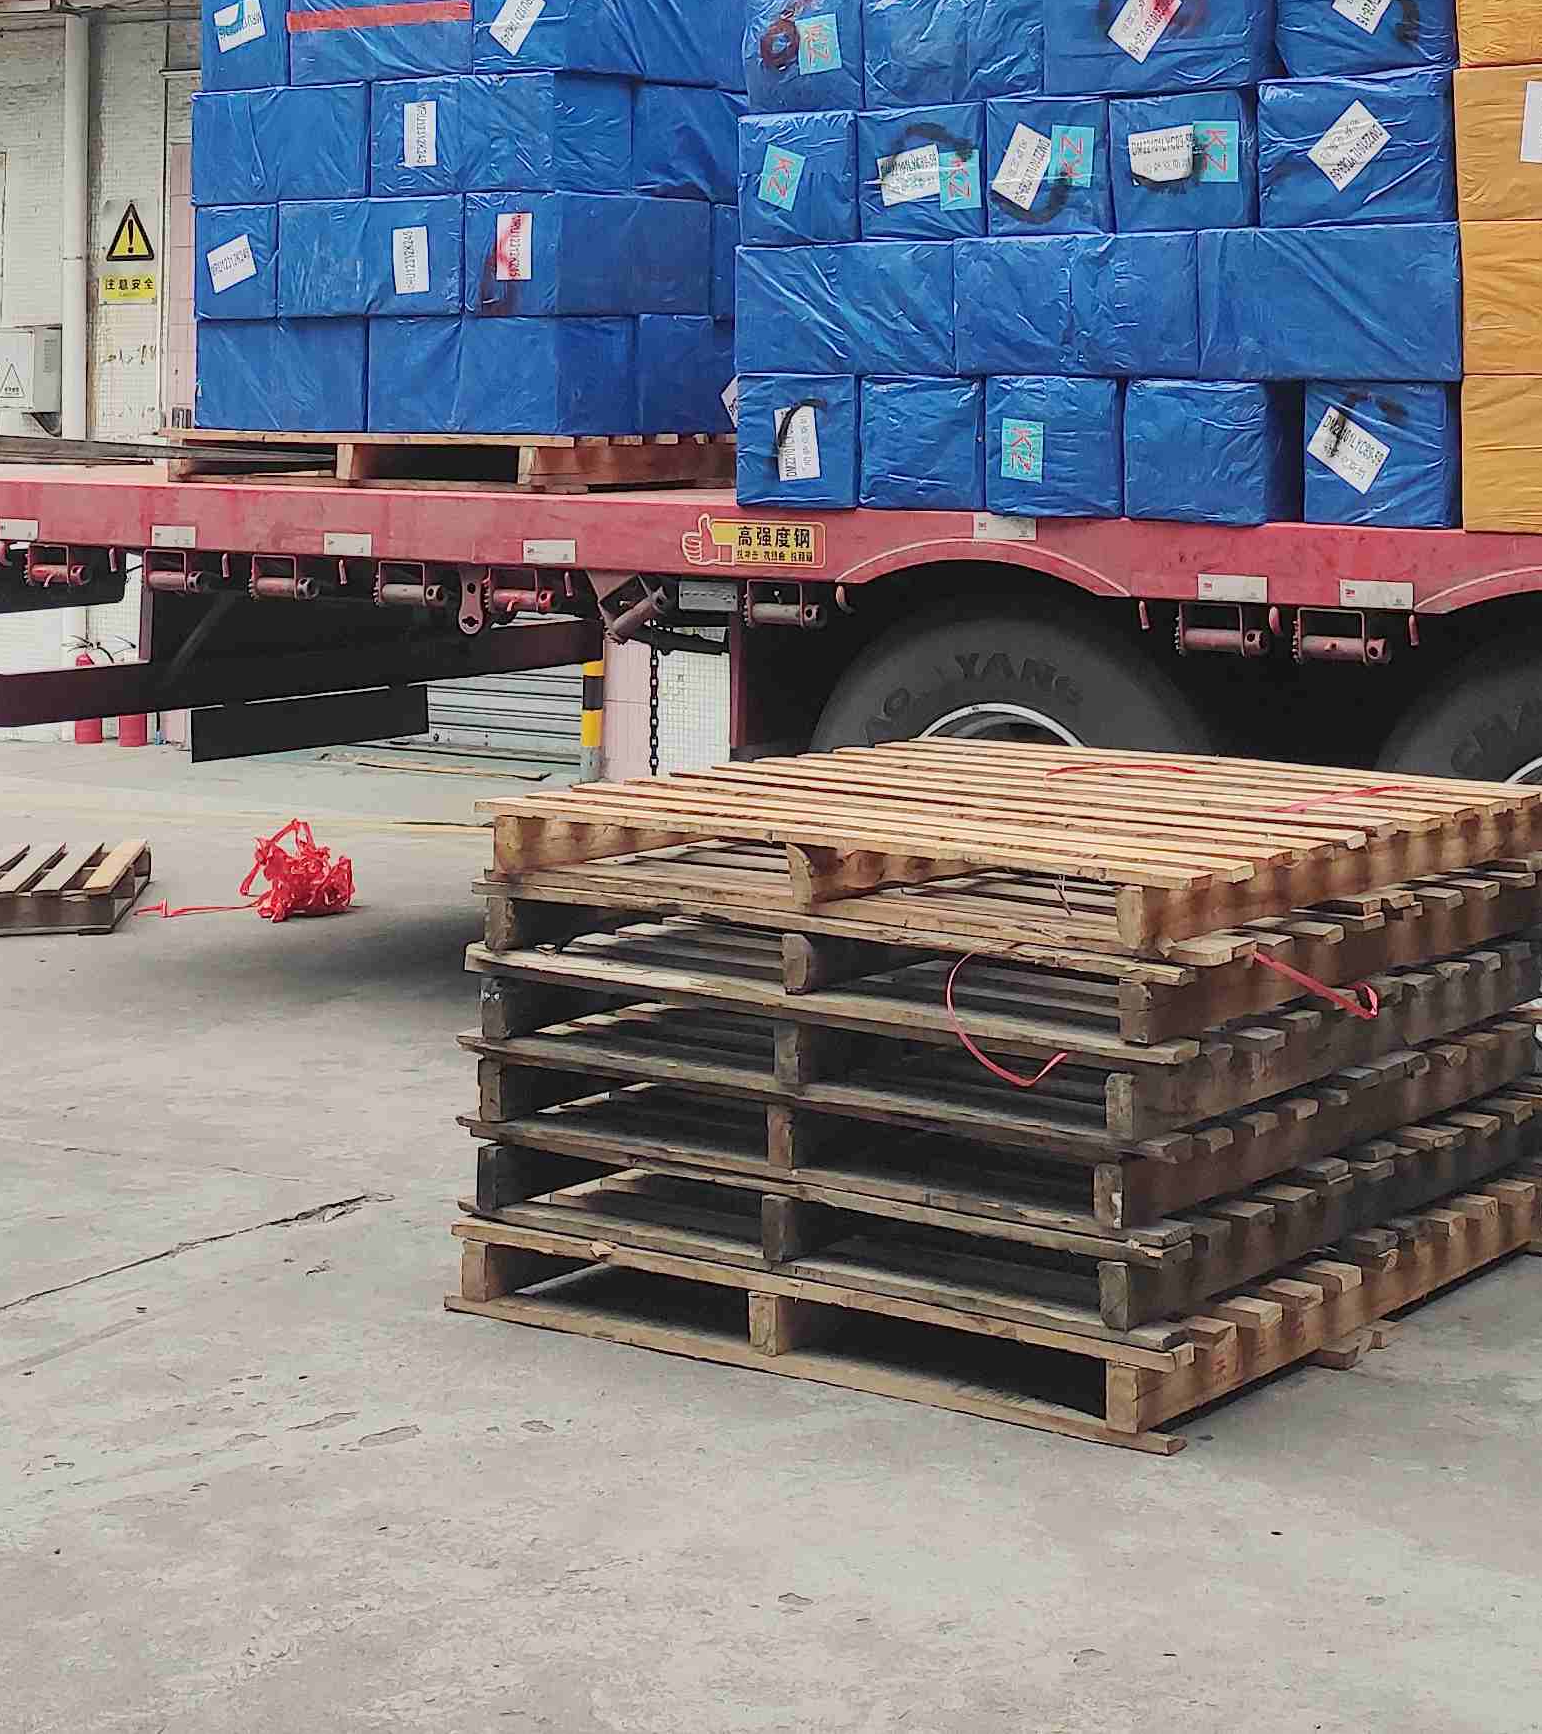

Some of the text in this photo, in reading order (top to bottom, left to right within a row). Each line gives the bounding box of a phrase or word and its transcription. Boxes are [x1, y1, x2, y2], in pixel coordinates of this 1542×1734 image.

[1202, 127, 1228, 173] KZ
[765, 153, 796, 199] KZ
[105, 277, 154, 291] 注意安全
[1008, 427, 1034, 473] KZ
[737, 525, 810, 548] 高强度钢
